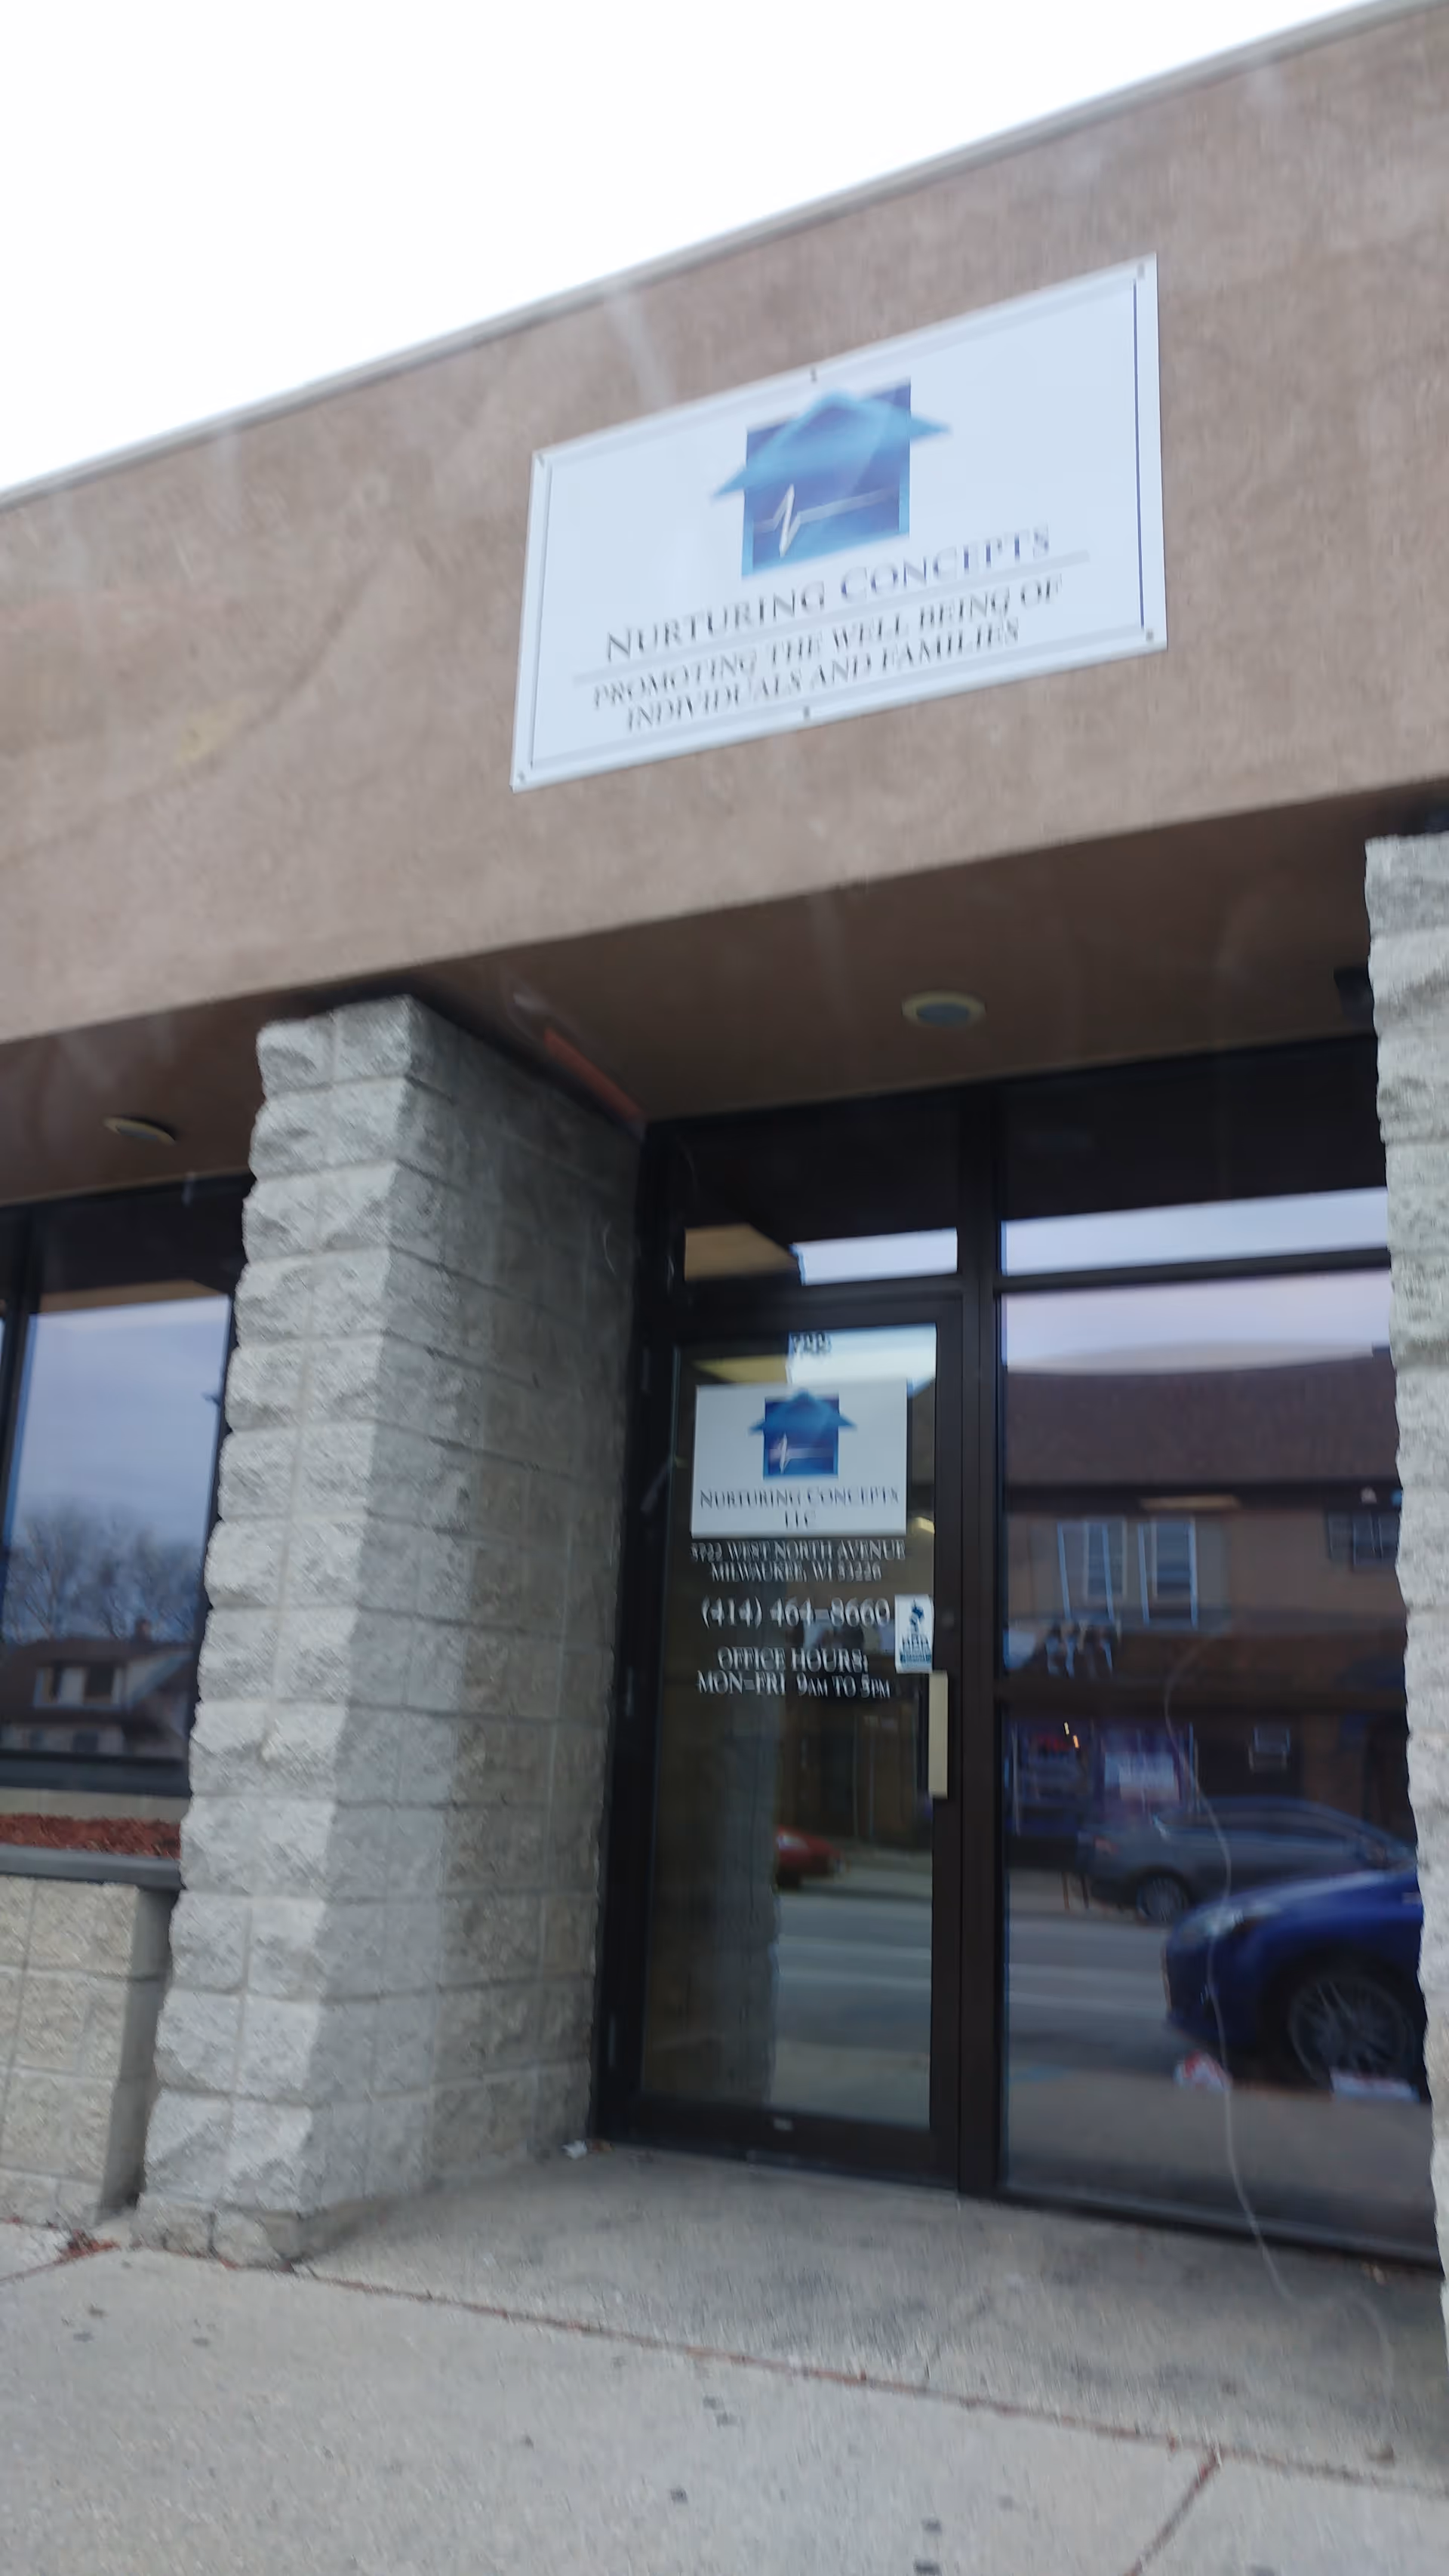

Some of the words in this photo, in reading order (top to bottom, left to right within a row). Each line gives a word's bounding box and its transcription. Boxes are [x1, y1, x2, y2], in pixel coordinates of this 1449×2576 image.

[605, 580, 825, 662] NURTURING
[841, 523, 1050, 605] CONCEPTS
[593, 648, 757, 709] PROMOTING
[769, 632, 825, 666] THE
[918, 586, 1011, 630] BEING
[1020, 574, 1063, 610] OF
[626, 669, 803, 732] INDIVIDUALS
[810, 653, 872, 688] AND
[882, 616, 1020, 672] FAMILIES
[699, 1488, 801, 1509] NURTURING
[804, 1485, 900, 1506] CONCEPTS
[726, 1540, 770, 1562] WEST
[774, 1540, 832, 1561] NORTH
[836, 1539, 906, 1561] AVENUE
[811, 1560, 832, 1582] WI
[701, 1596, 762, 1629] (414)
[718, 1646, 786, 1671] OFFICE
[697, 1670, 786, 1695] MON-FRI
[832, 1675, 857, 1697] TO
